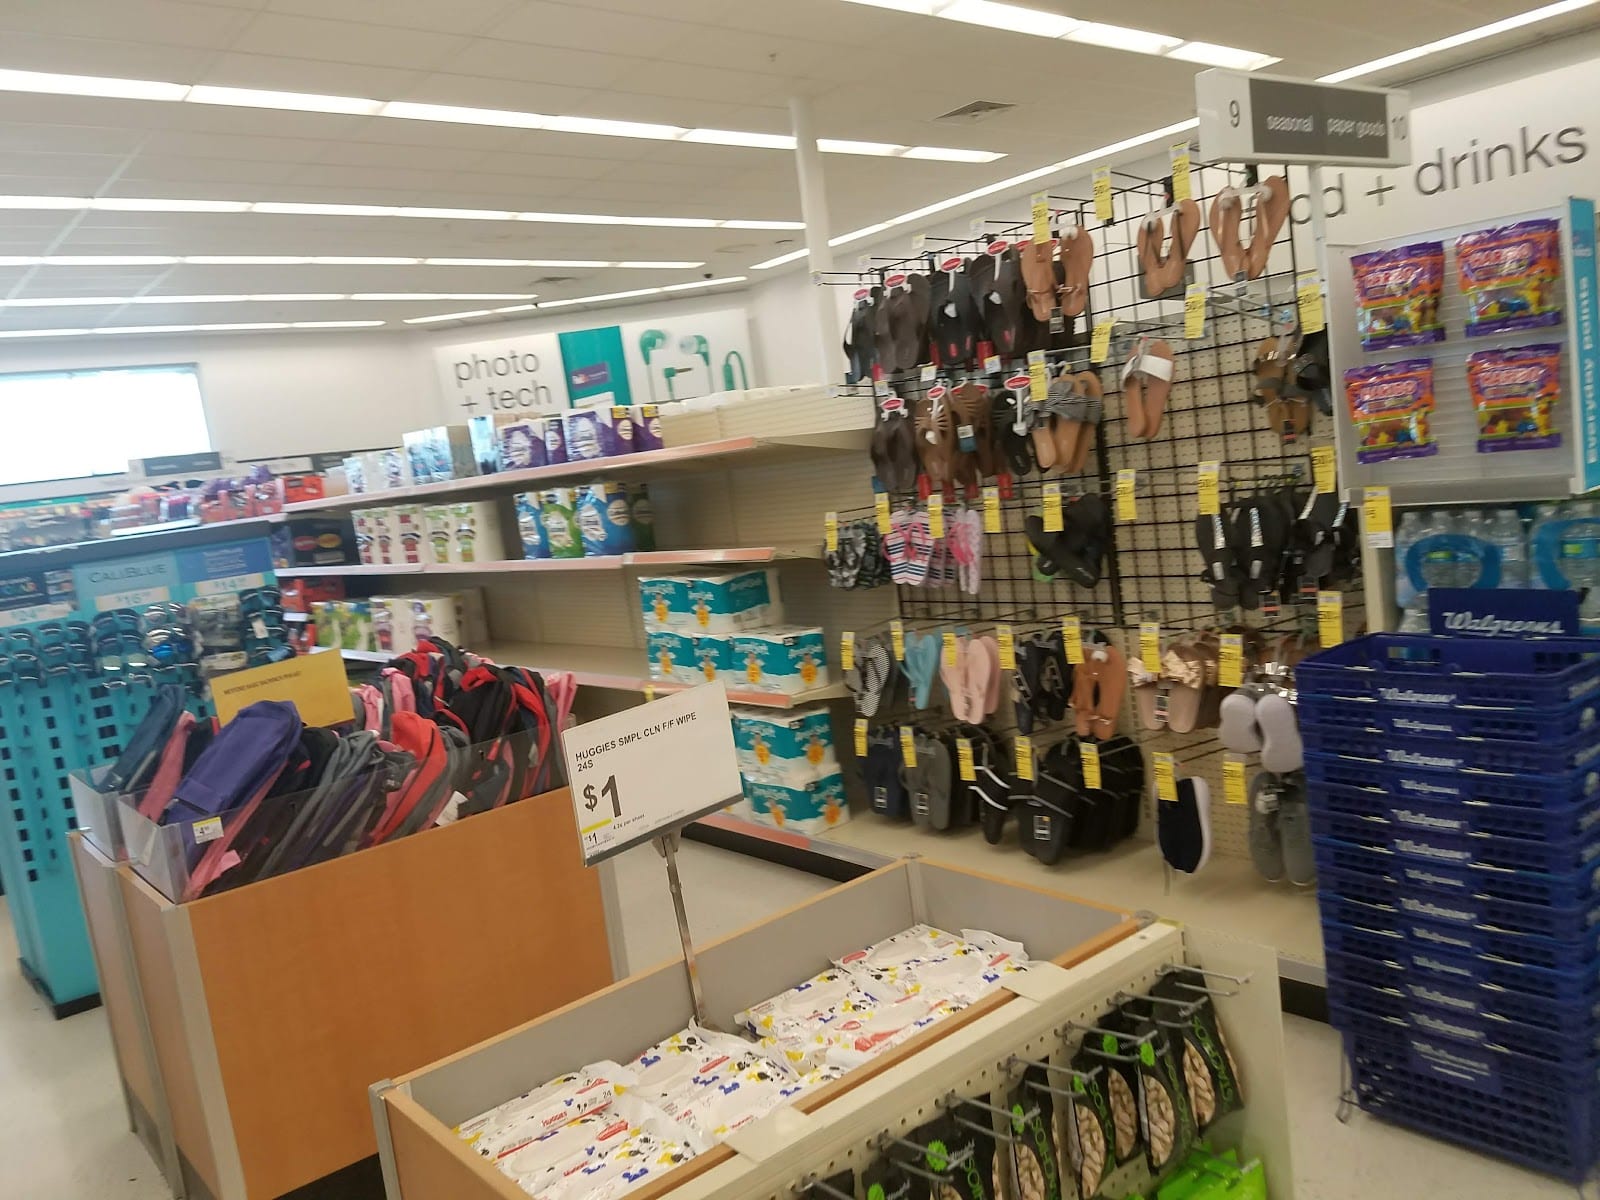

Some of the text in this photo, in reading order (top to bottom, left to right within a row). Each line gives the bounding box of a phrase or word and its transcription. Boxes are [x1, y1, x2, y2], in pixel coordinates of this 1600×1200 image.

[1228, 99, 1241, 129] 9
[1265, 115, 1314, 133] seasonal
[1326, 117, 1387, 140] paper goods
[1415, 125, 1589, 197] drinks
[453, 351, 540, 389] photo
[487, 380, 552, 411] tech
[1441, 611, 1566, 637] Walgreens
[575, 740, 617, 762] HUGGIES
[618, 731, 642, 744] SMPL
[643, 723, 662, 738] CLN
[675, 712, 697, 726] WIPE
[577, 759, 594, 773] 24S
[582, 774, 622, 819] $1
